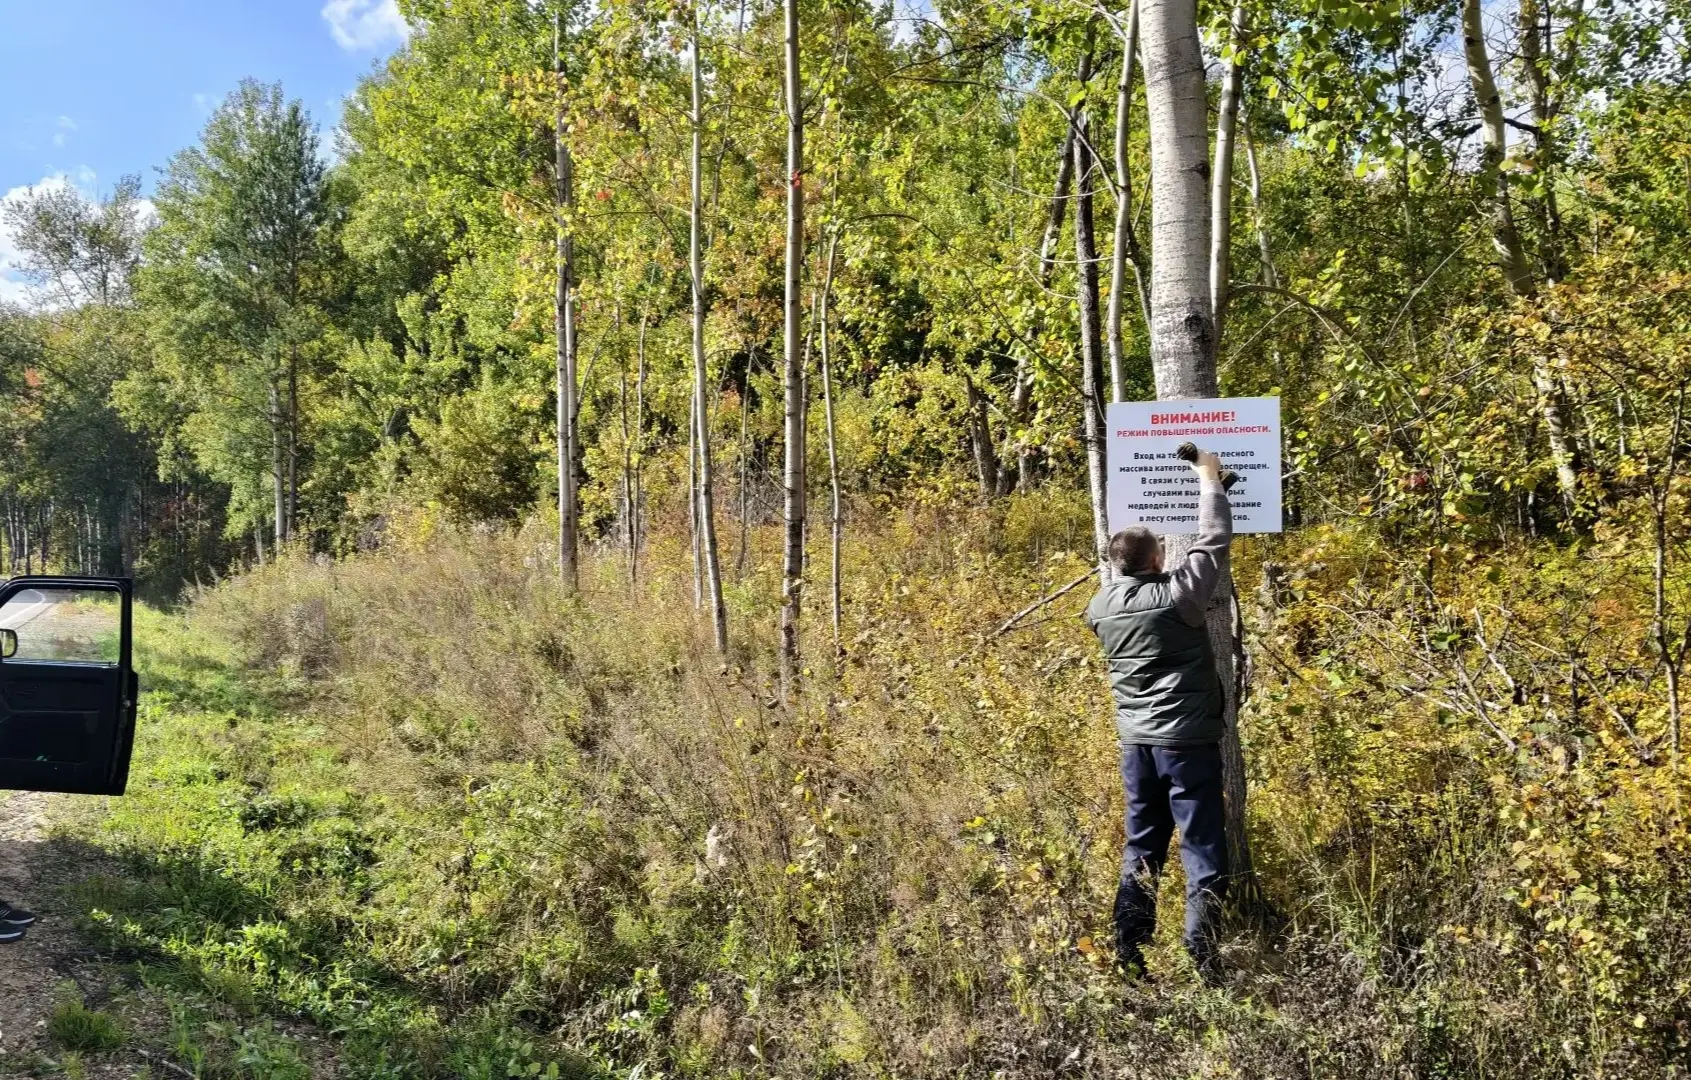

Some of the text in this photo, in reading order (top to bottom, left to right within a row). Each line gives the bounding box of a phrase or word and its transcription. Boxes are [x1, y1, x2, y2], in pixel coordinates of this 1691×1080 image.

[1151, 411, 1235, 425] ВНИМАНИЕ!
[1151, 428, 1214, 436] ПОВЫШЕННОЙ
[1216, 425, 1271, 434] ОПАСНОСТИ.
[1134, 452, 1154, 460] Вход
[1119, 465, 1153, 473] массива
[1143, 490, 1182, 498] случаями
